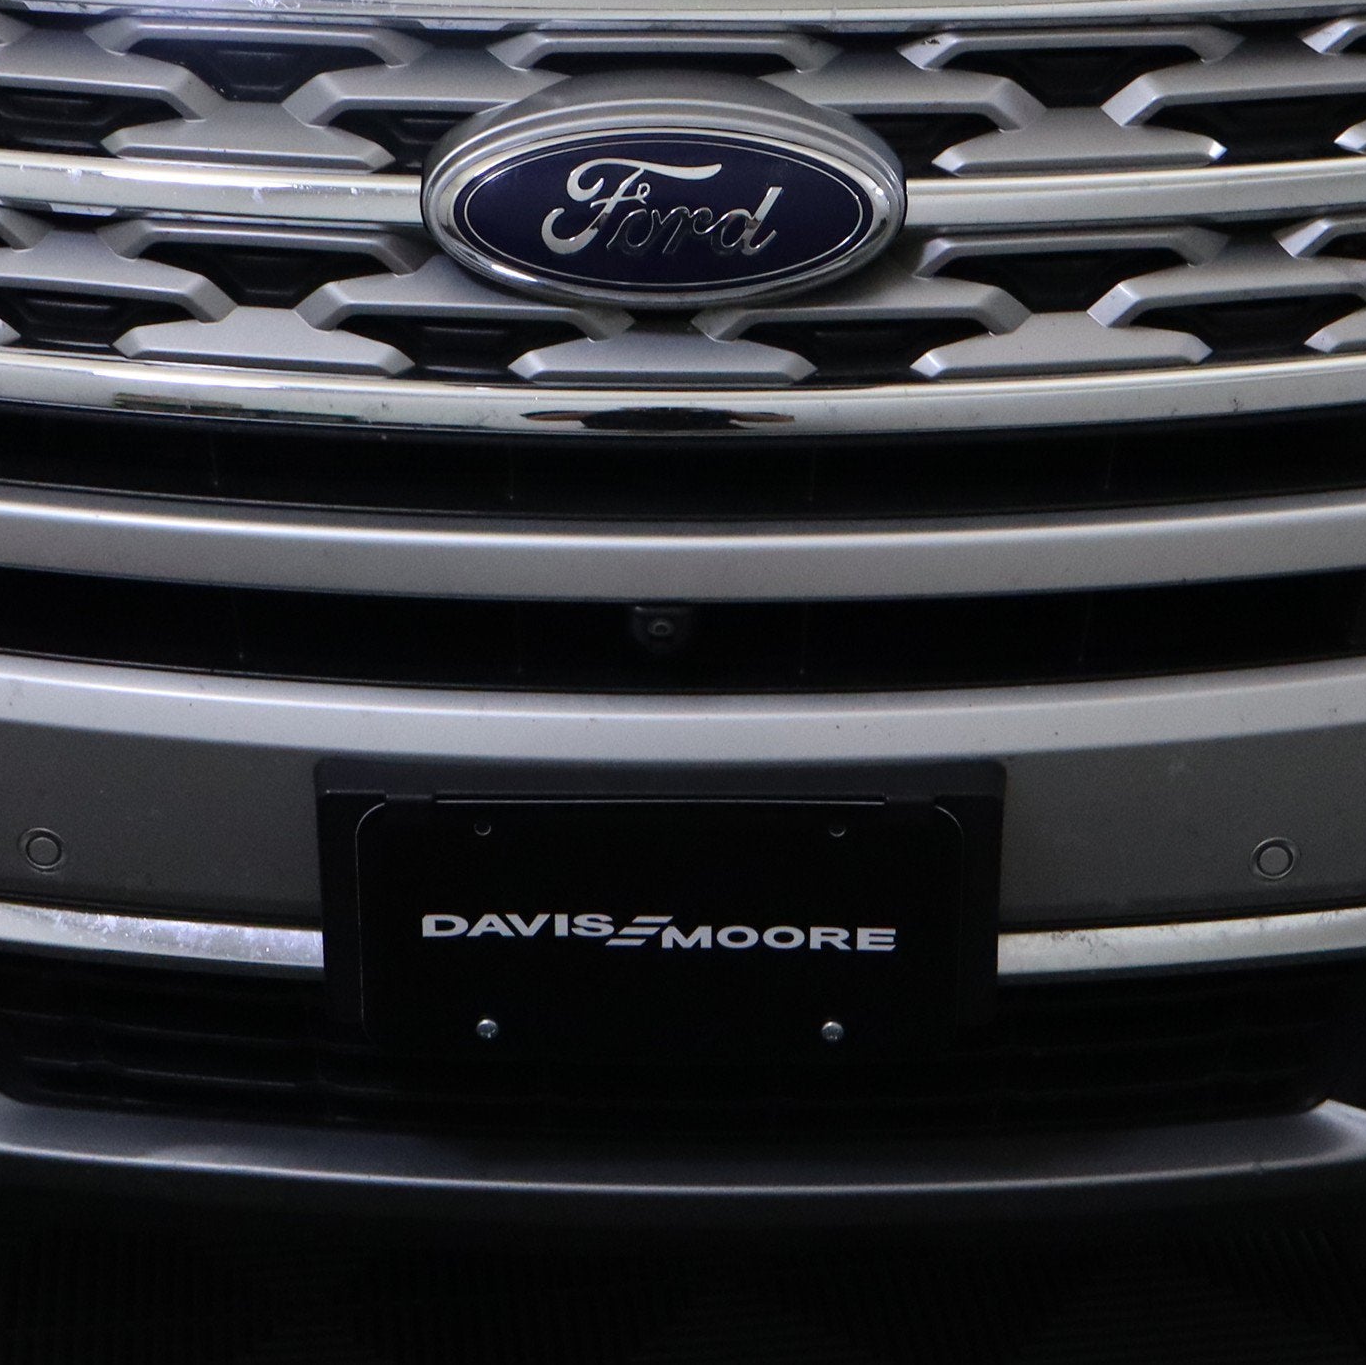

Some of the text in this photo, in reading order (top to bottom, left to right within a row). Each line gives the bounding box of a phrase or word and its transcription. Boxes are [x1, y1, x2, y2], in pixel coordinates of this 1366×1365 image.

[540, 157, 783, 257] Ford
[421, 913, 897, 951] DAVIS MOORE
